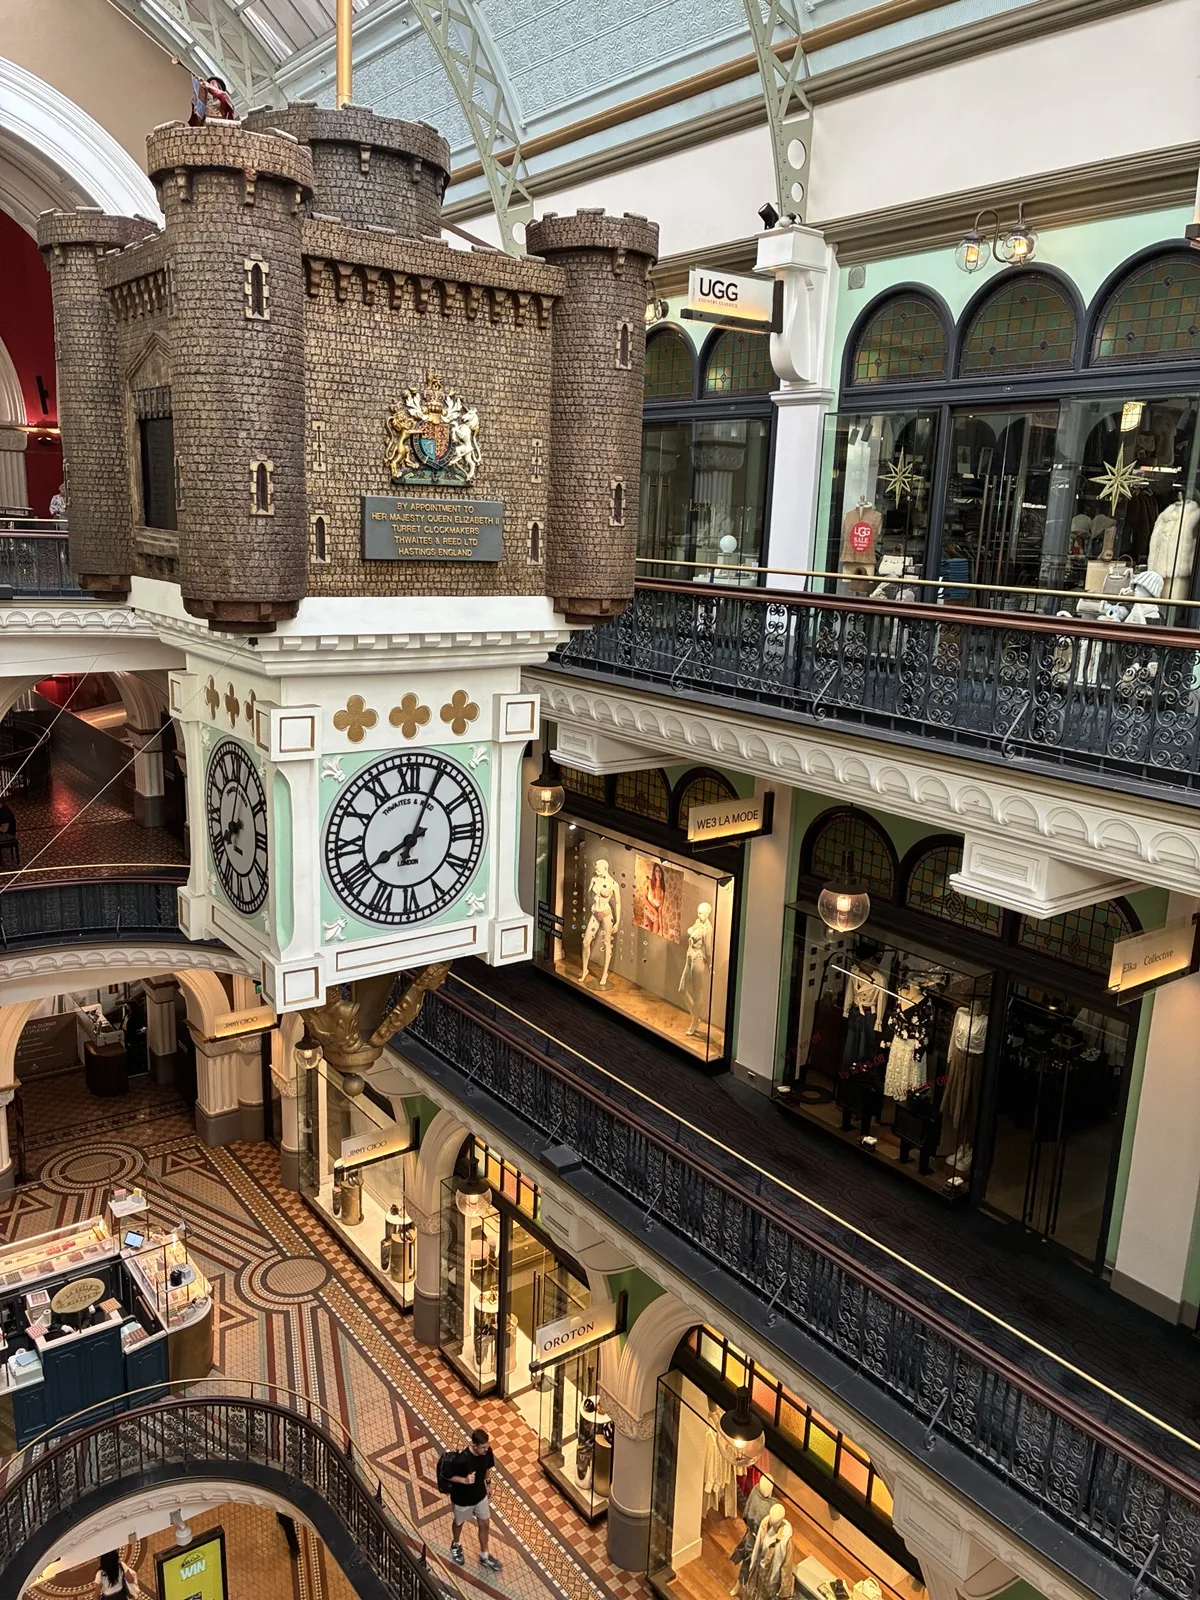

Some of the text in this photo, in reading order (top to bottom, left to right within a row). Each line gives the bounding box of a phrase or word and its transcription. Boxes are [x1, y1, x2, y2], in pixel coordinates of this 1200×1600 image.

[700, 277, 738, 302] UGG
[397, 502, 474, 513] BY APPOINTMENT TO
[371, 512, 386, 520] HER
[389, 513, 424, 522] MAJESTY
[427, 515, 452, 523] QUEEN
[455, 516, 493, 524] ELIZABETH
[392, 524, 479, 535] TURRET CLOCKMAKERS
[853, 526, 871, 537] UGG
[394, 535, 478, 546] THWAITES & REED LTD
[853, 536, 869, 544] SALE
[398, 547, 472, 557] HASTINGS ENGLAND
[398, 766, 420, 793] XII
[365, 776, 390, 807] XI
[382, 798, 411, 816] THWAITES
[420, 800, 434, 811] RED
[446, 791, 468, 814] II
[345, 803, 371, 826] X
[697, 810, 759, 829] WE3 LA MODE
[452, 823, 475, 843] III
[397, 858, 419, 867] LONDON
[1143, 949, 1174, 966] Collective
[224, 1016, 259, 1029] JIMMY CHOO
[348, 1140, 387, 1158] JIMMY CHOO
[543, 1322, 595, 1351] OROTON
[180, 1559, 206, 1580] WIN
